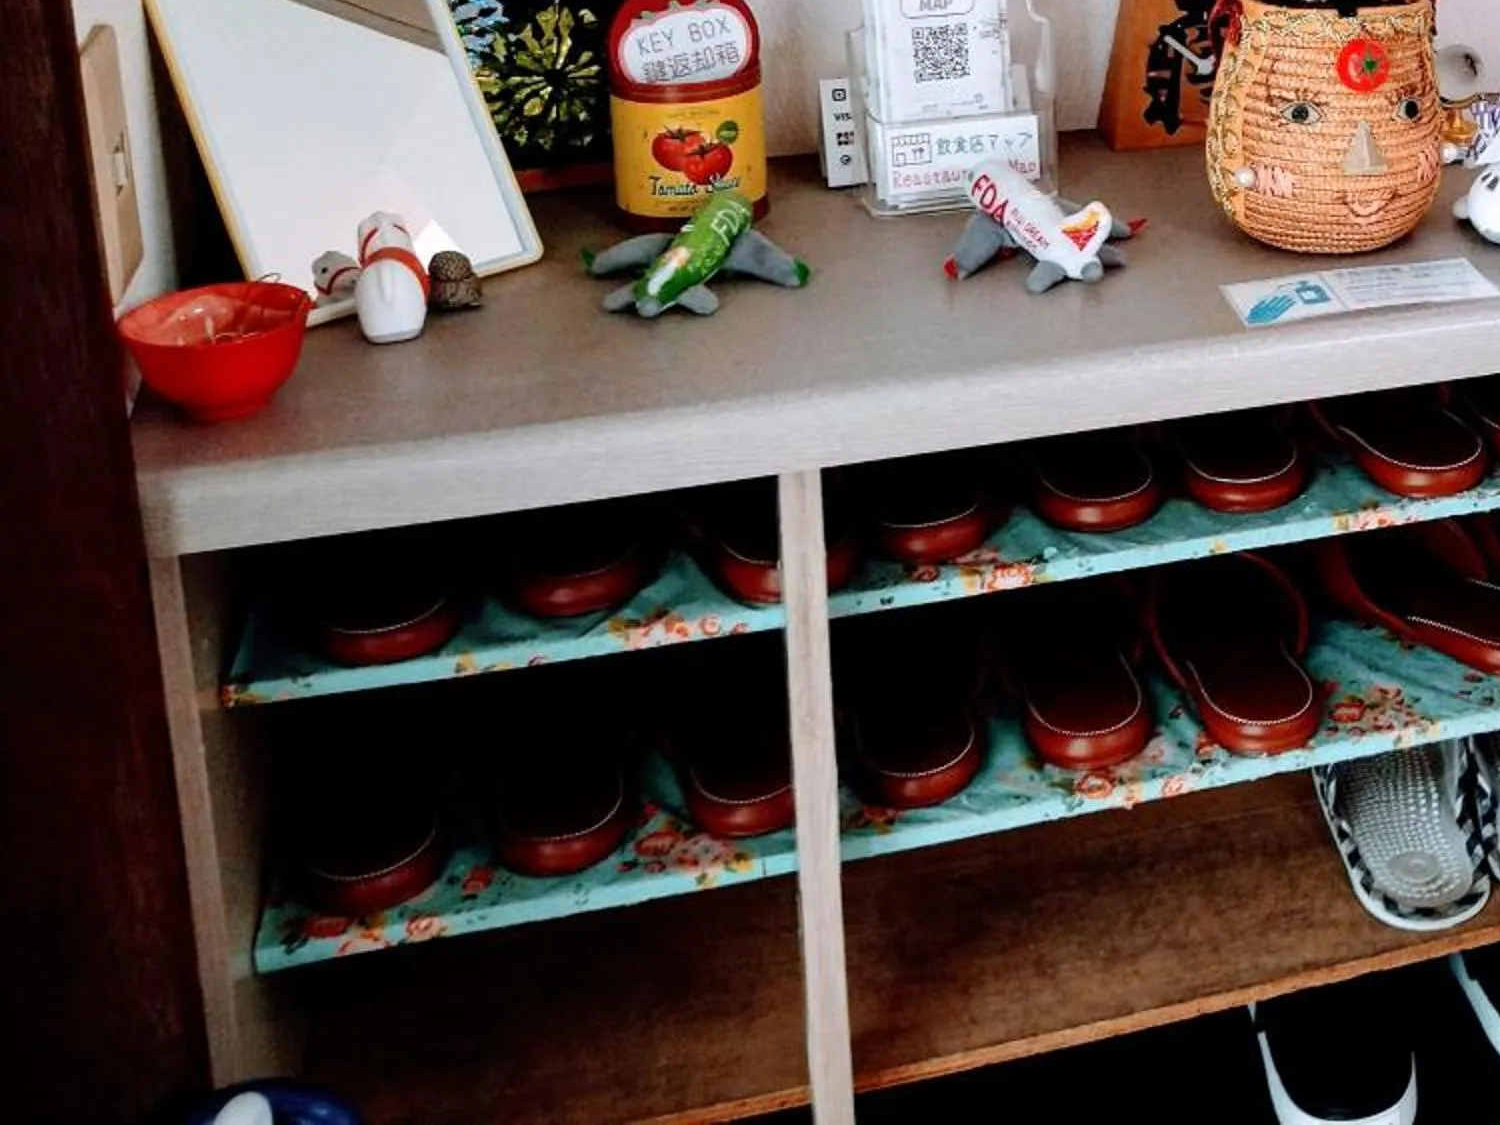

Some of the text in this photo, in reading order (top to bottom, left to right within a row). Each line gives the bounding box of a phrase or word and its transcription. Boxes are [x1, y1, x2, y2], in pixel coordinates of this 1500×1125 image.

[636, 15, 732, 56] KEY BOX
[648, 176, 698, 196] Tomato
[892, 167, 975, 191] Reastaur
